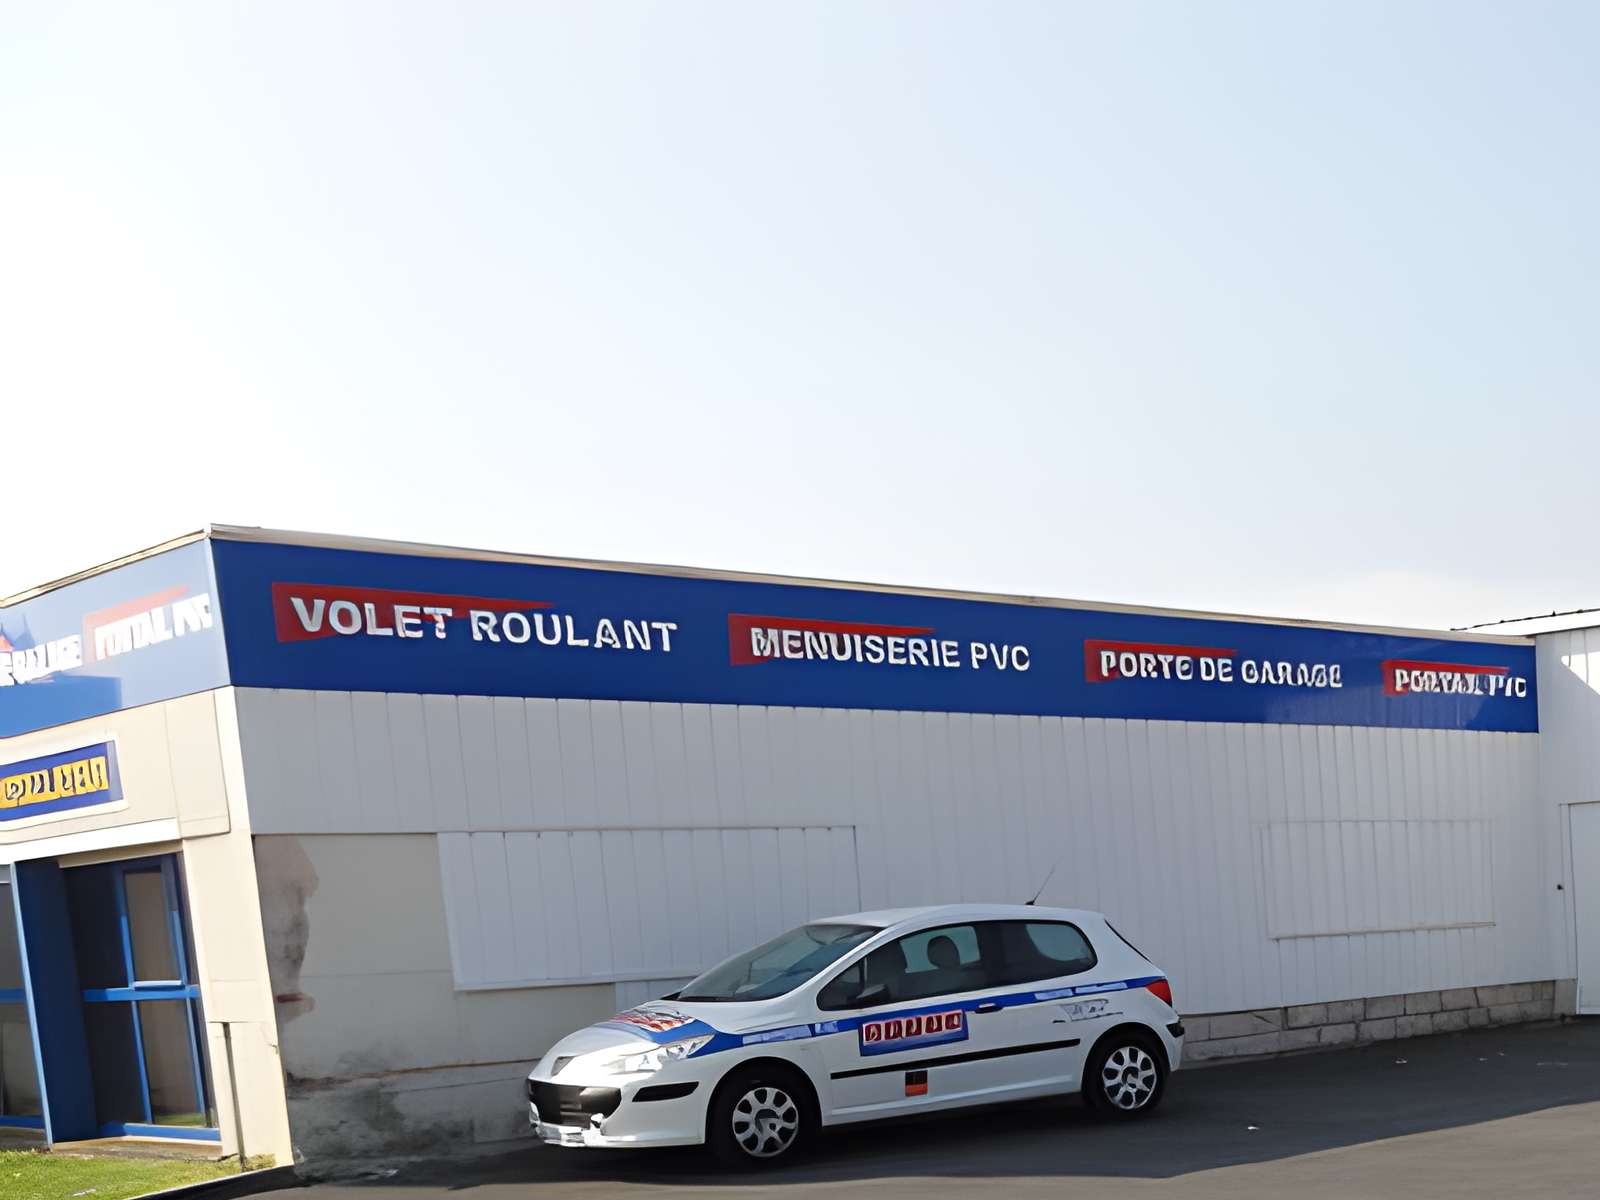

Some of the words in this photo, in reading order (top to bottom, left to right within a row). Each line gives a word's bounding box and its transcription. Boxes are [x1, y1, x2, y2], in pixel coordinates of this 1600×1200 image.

[290, 597, 452, 639] VOLET
[469, 610, 677, 651] ROULANT
[751, 627, 960, 667] MENUISERIE
[970, 642, 1030, 671] PVC
[1200, 656, 1233, 682] DE
